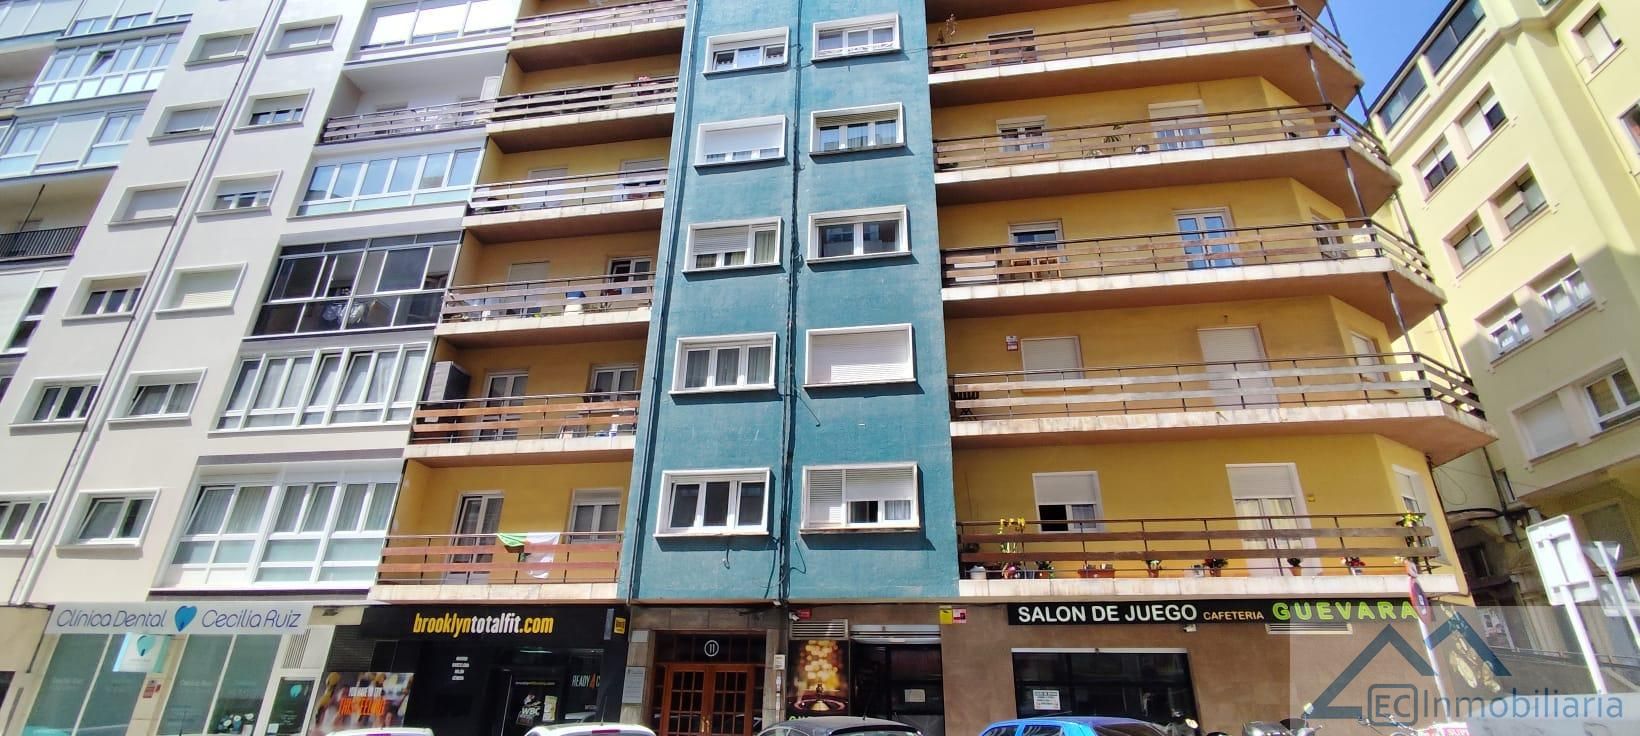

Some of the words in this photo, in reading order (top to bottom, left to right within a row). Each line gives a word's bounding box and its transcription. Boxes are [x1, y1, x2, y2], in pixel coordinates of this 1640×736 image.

[56, 609, 111, 628] Clínica
[112, 610, 168, 628] Dental
[201, 609, 261, 628] Cecilia
[264, 610, 302, 628] Ruiz
[1018, 605, 1086, 622] SALON
[1092, 605, 1120, 622] DE
[1124, 604, 1198, 621] JUEGO
[1203, 611, 1265, 621] CAFETERIA
[1272, 601, 1419, 621] GUEVARA
[413, 612, 555, 638] brooklyntotalfit.com
[572, 675, 591, 687] READY
